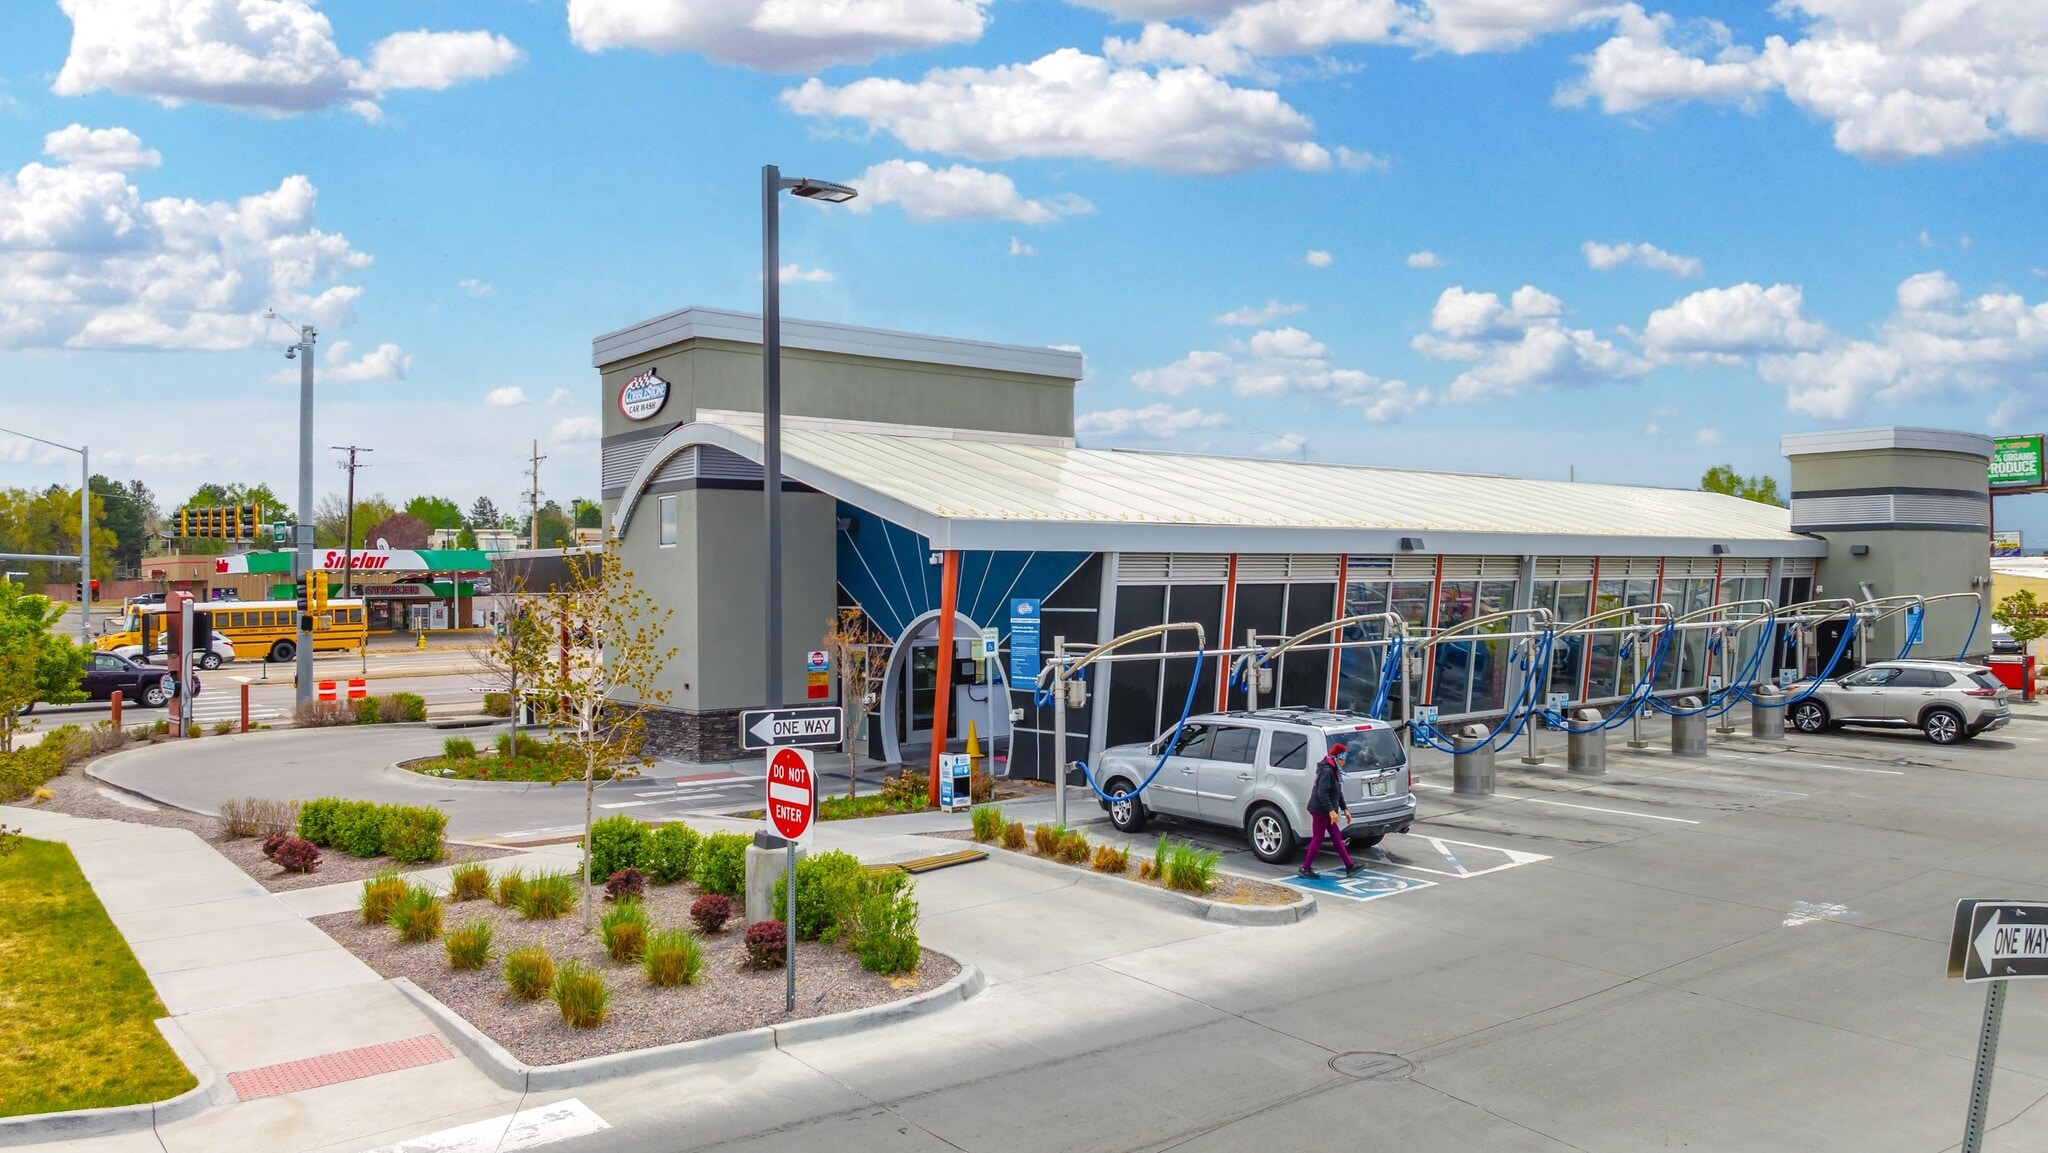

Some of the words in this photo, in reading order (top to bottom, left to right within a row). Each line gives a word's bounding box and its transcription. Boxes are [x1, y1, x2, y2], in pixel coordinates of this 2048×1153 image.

[629, 404, 640, 414] CAR
[641, 401, 656, 411] WASH
[2003, 451, 2037, 461] ORGANIC
[1988, 460, 2037, 474] RODUCE
[365, 585, 420, 595] STINKER
[773, 721, 799, 735] ONE
[804, 719, 831, 733] WAY
[773, 764, 785, 779] DO
[788, 767, 806, 783] NOT
[775, 804, 802, 823] ENTER
[1994, 928, 2021, 955] ONE
